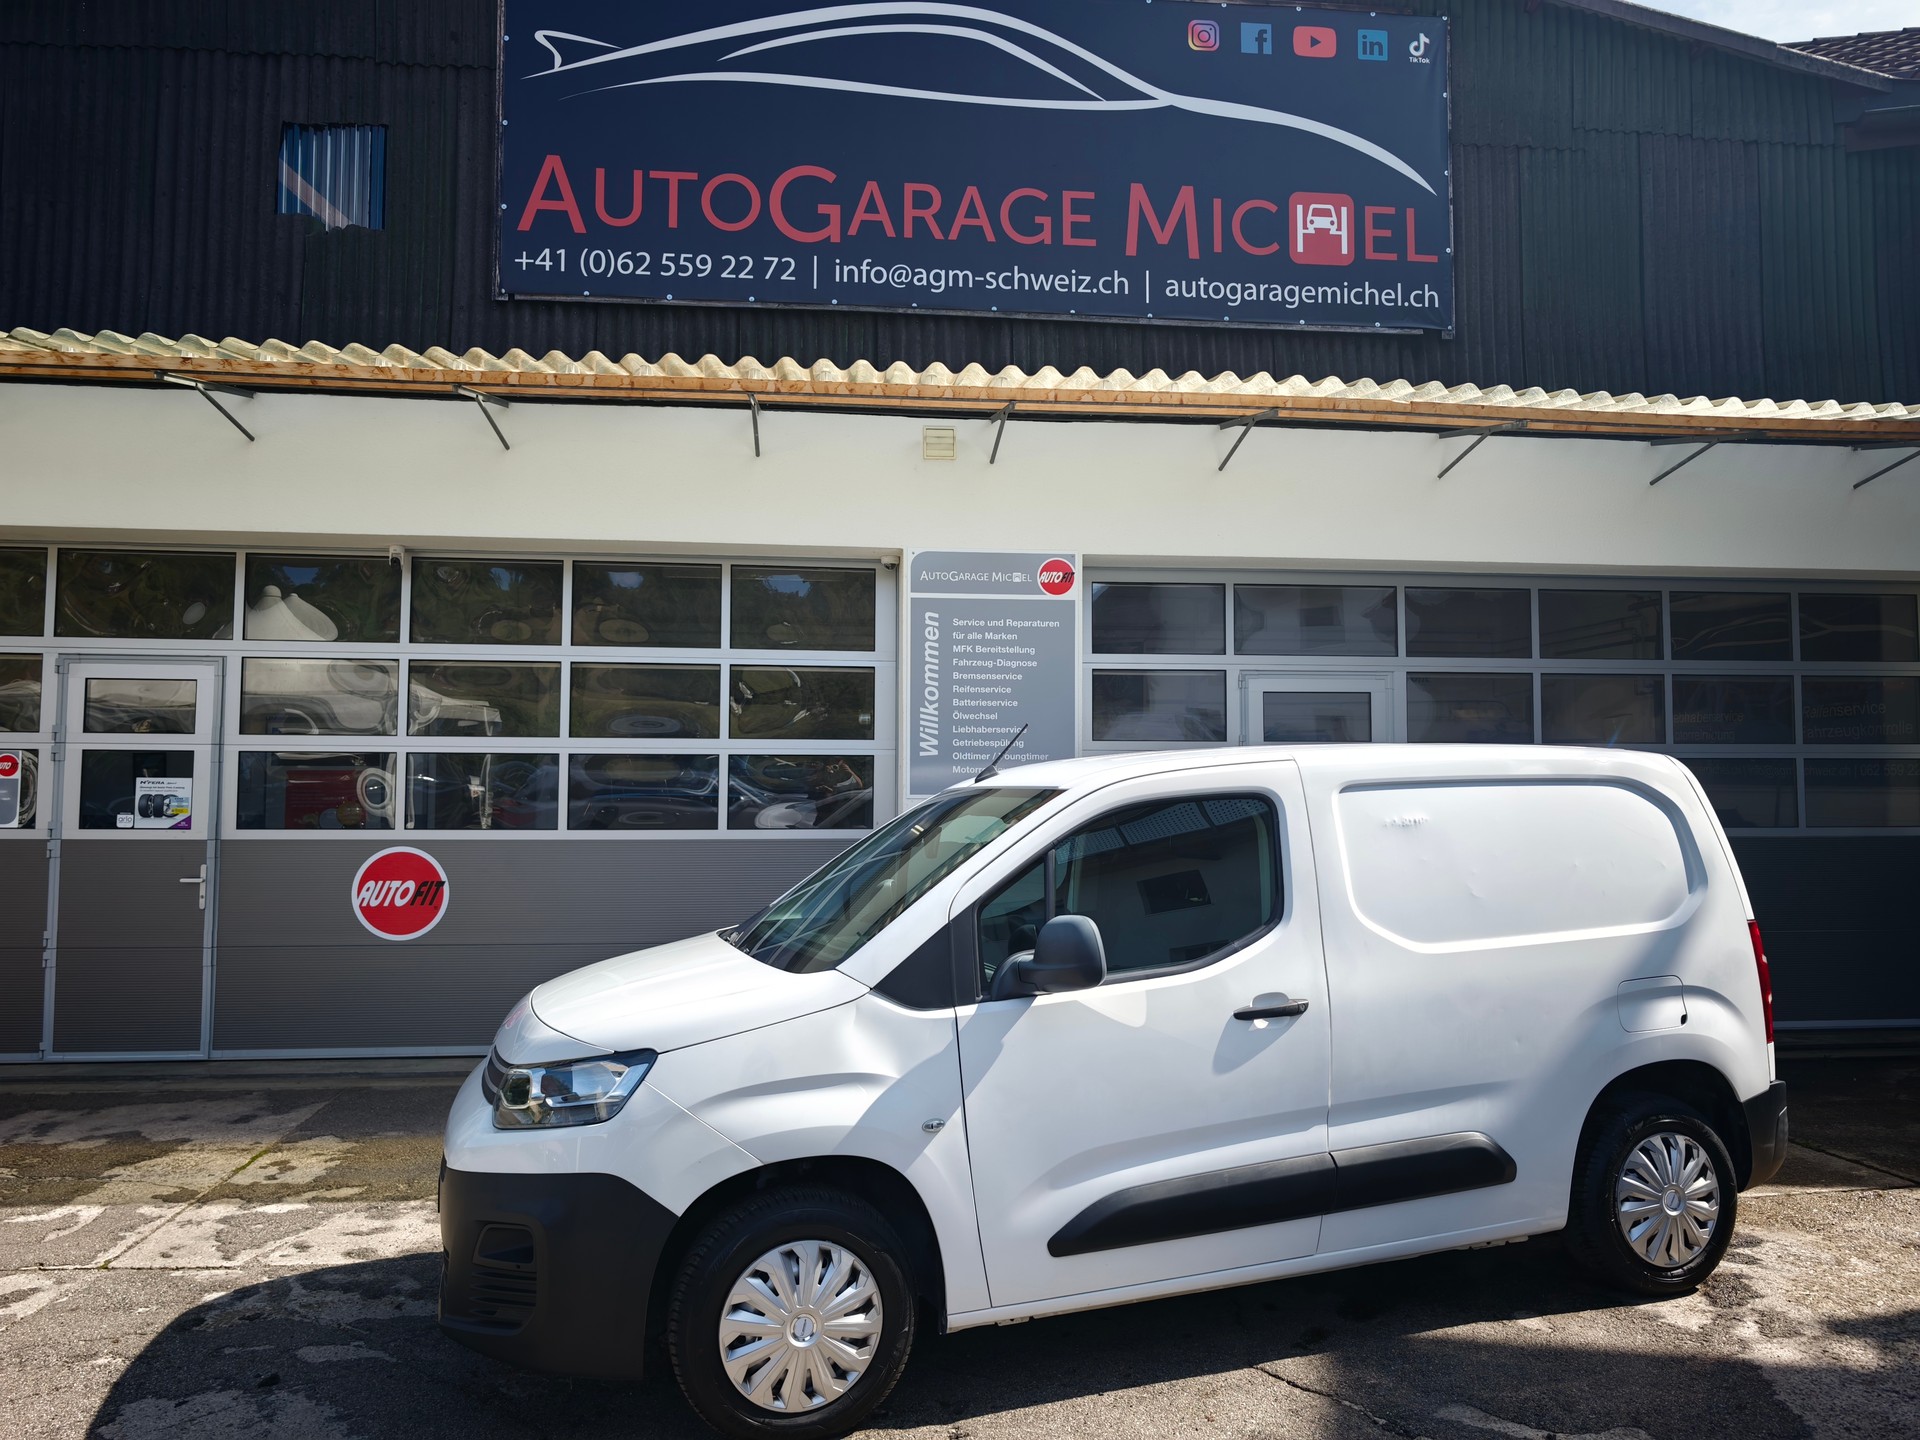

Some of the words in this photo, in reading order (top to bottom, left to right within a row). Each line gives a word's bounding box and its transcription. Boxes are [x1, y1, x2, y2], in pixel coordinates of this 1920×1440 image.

[514, 248, 567, 272] +41
[580, 248, 651, 278] (0)62
[660, 253, 713, 278] 559
[720, 255, 754, 279] 22
[763, 256, 797, 281] 72
[834, 258, 1129, 295] info@agm-schweiz.ch
[1165, 275, 1439, 309] autogaragemichel.ch
[952, 618, 985, 627] Service
[987, 618, 1004, 627] und
[1006, 619, 1060, 629] Reparaturen
[952, 631, 965, 640] für
[967, 632, 982, 640] alle
[985, 632, 1018, 640] Marken
[953, 645, 973, 653] MFK
[975, 645, 1035, 655] Bereitstellung
[953, 658, 1037, 668] Fahrzeug-Diagnose
[953, 672, 1022, 681] Bremsenservice
[919, 611, 940, 757] Willkommen
[953, 685, 1012, 694] Reifenservice
[953, 698, 1018, 707] Batterieservice
[952, 711, 998, 720] Ölwechsel
[1804, 719, 1914, 739] ahrzeugkontrolle
[952, 738, 1024, 748] Getriebespülng
[952, 752, 990, 761] Oldtimer
[999, 752, 1049, 762] oungtimer
[357, 880, 446, 908] AUTOFIT
